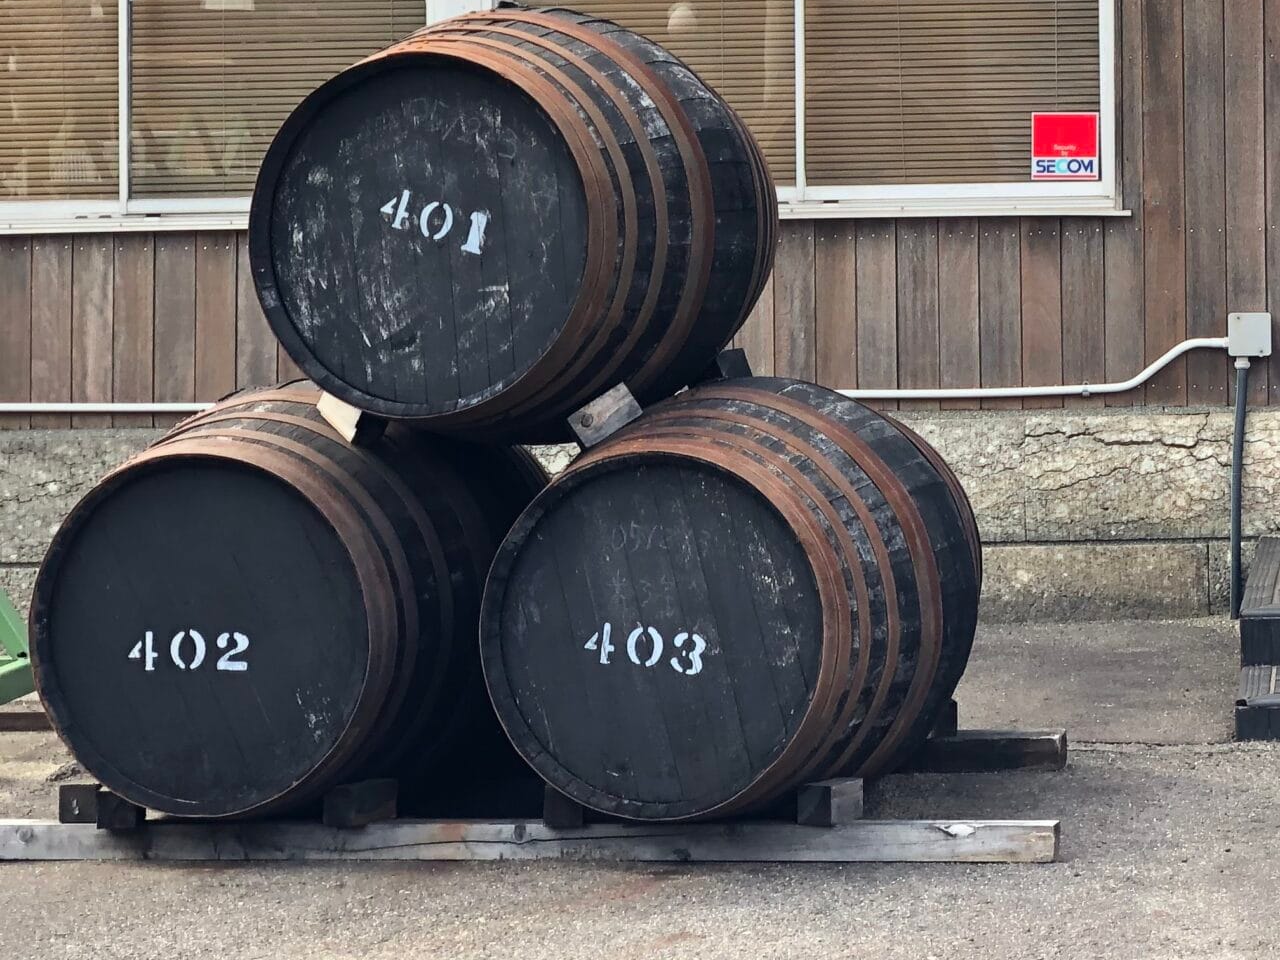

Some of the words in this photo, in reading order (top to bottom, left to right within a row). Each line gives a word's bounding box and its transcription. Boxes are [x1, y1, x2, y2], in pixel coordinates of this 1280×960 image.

[1036, 159, 1094, 173] SECOM
[380, 190, 489, 255] 401
[128, 629, 249, 671] 402
[584, 622, 706, 675] 403
